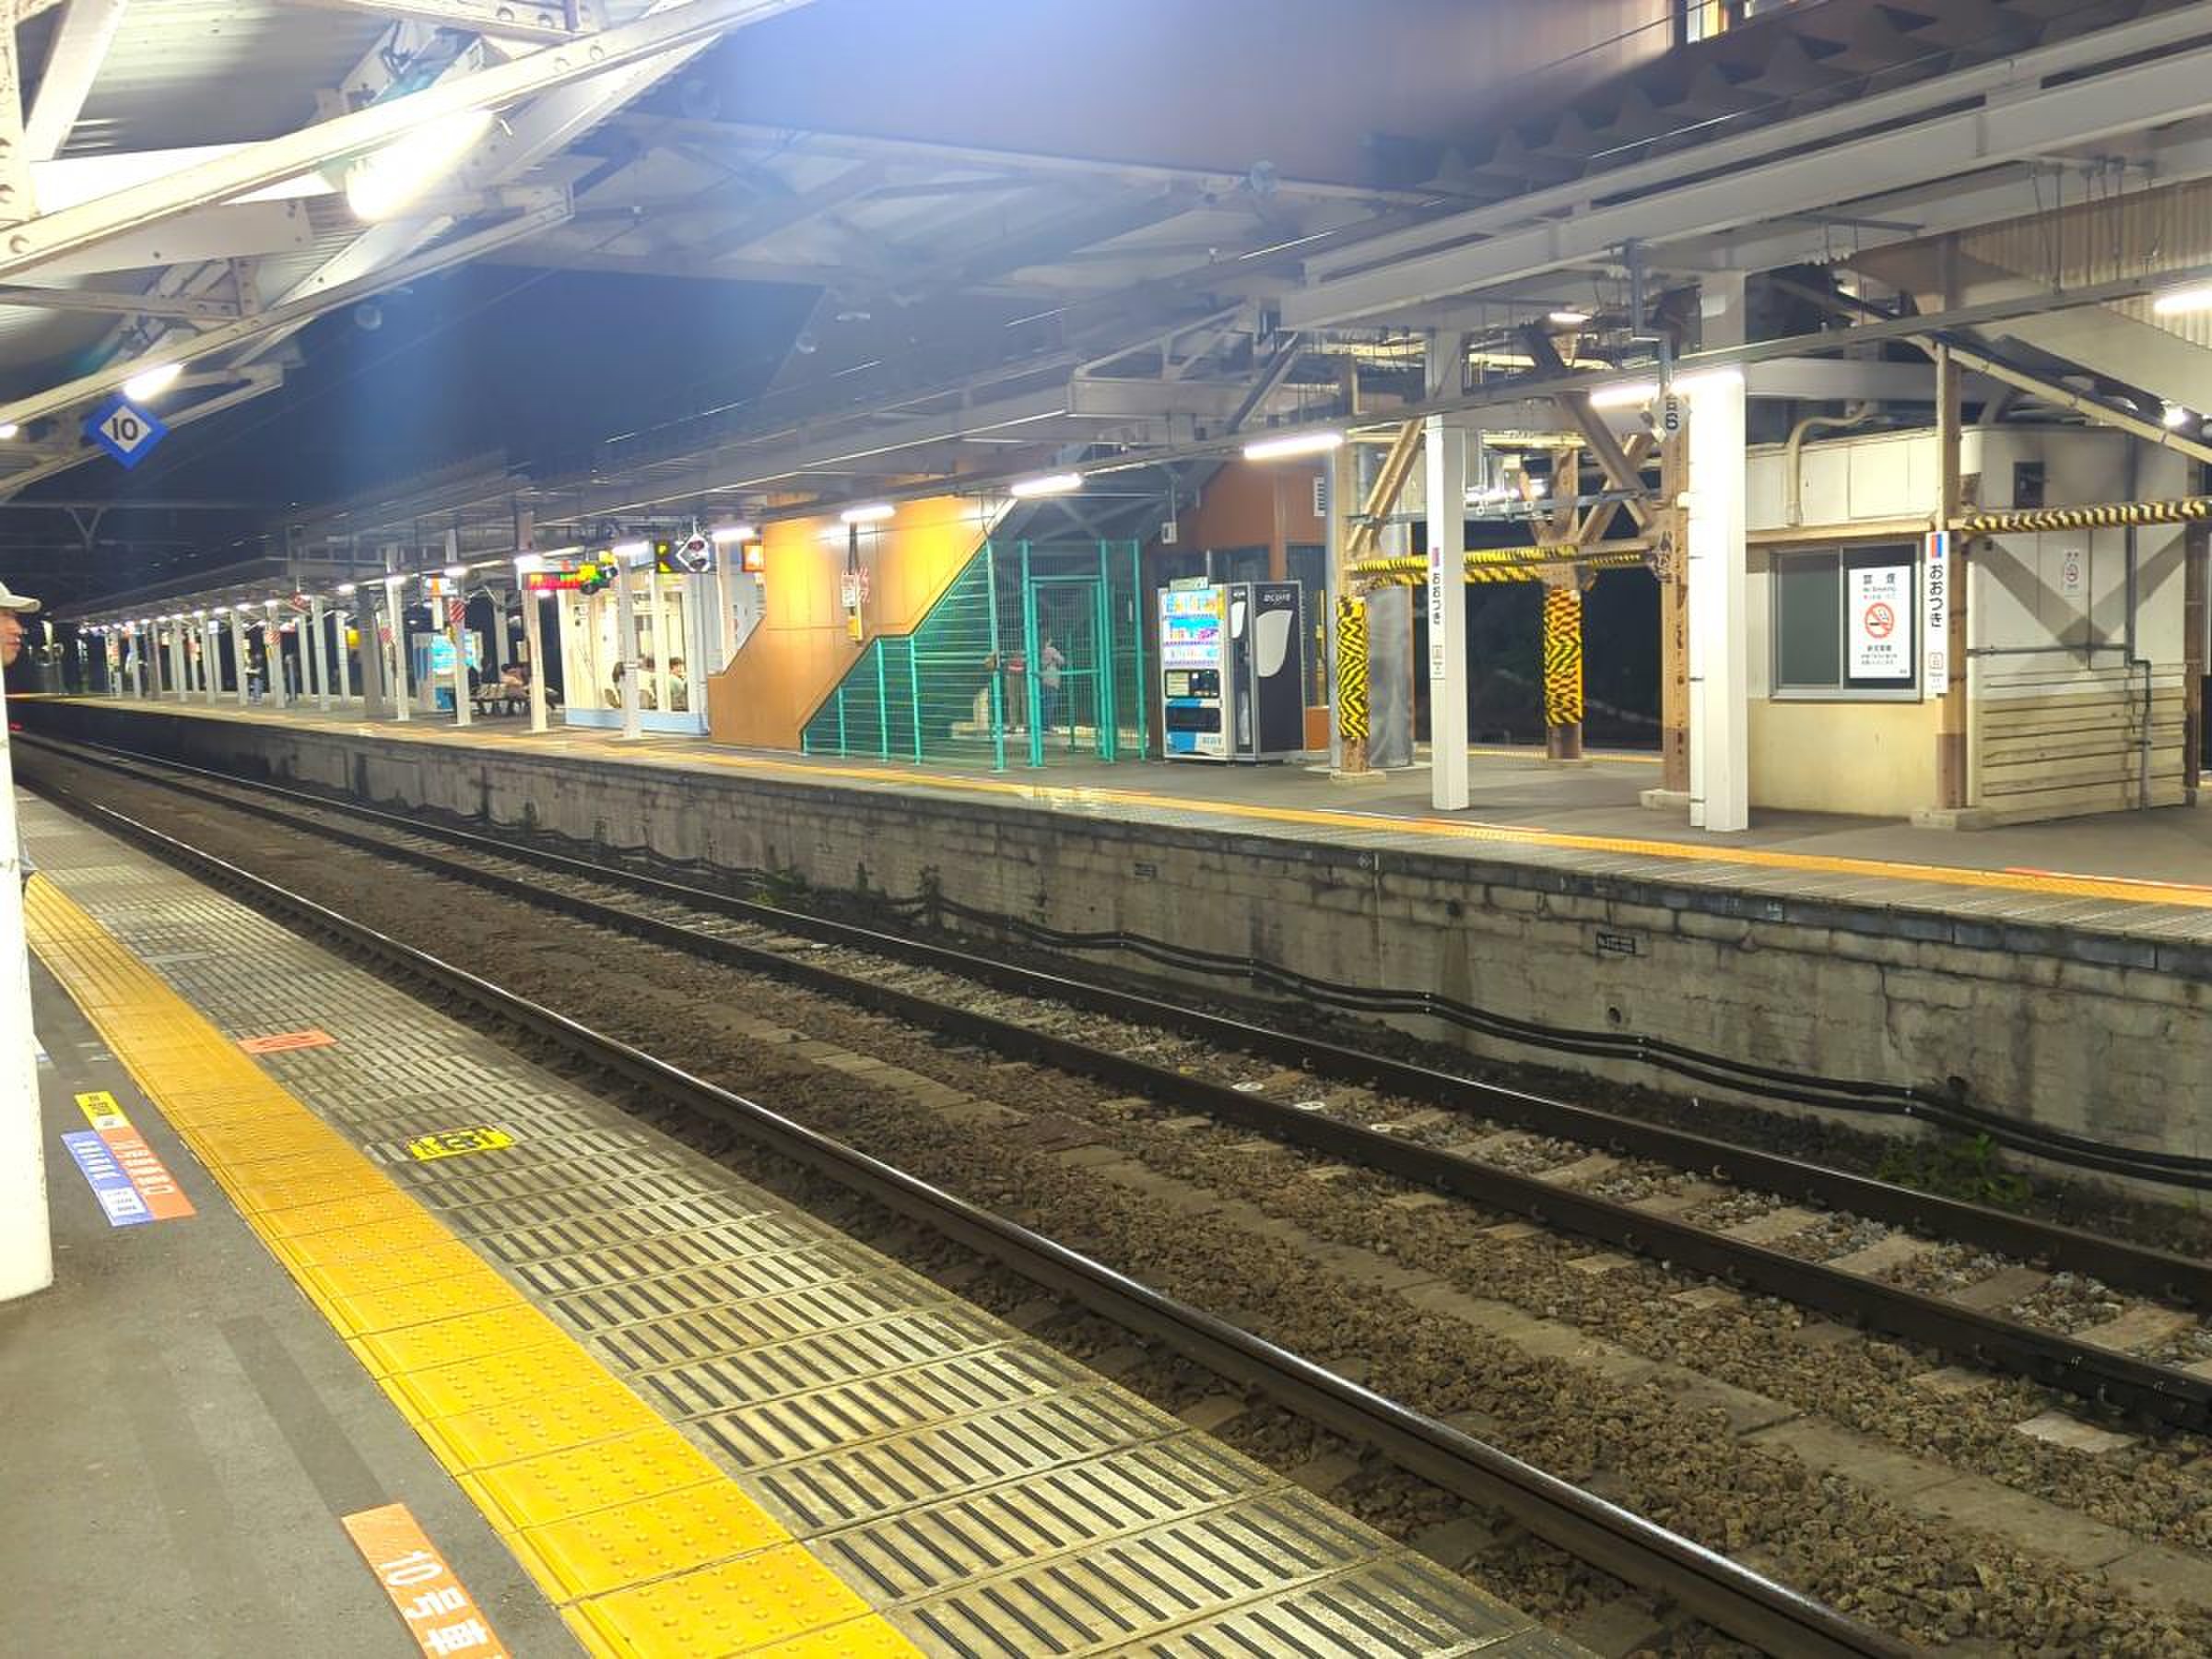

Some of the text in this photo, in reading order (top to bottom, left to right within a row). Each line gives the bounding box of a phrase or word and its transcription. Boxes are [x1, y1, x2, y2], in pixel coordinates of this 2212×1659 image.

[112, 418, 138, 441] 10
[1929, 564, 1944, 628] おおつき
[378, 1550, 498, 1659] 10号車
